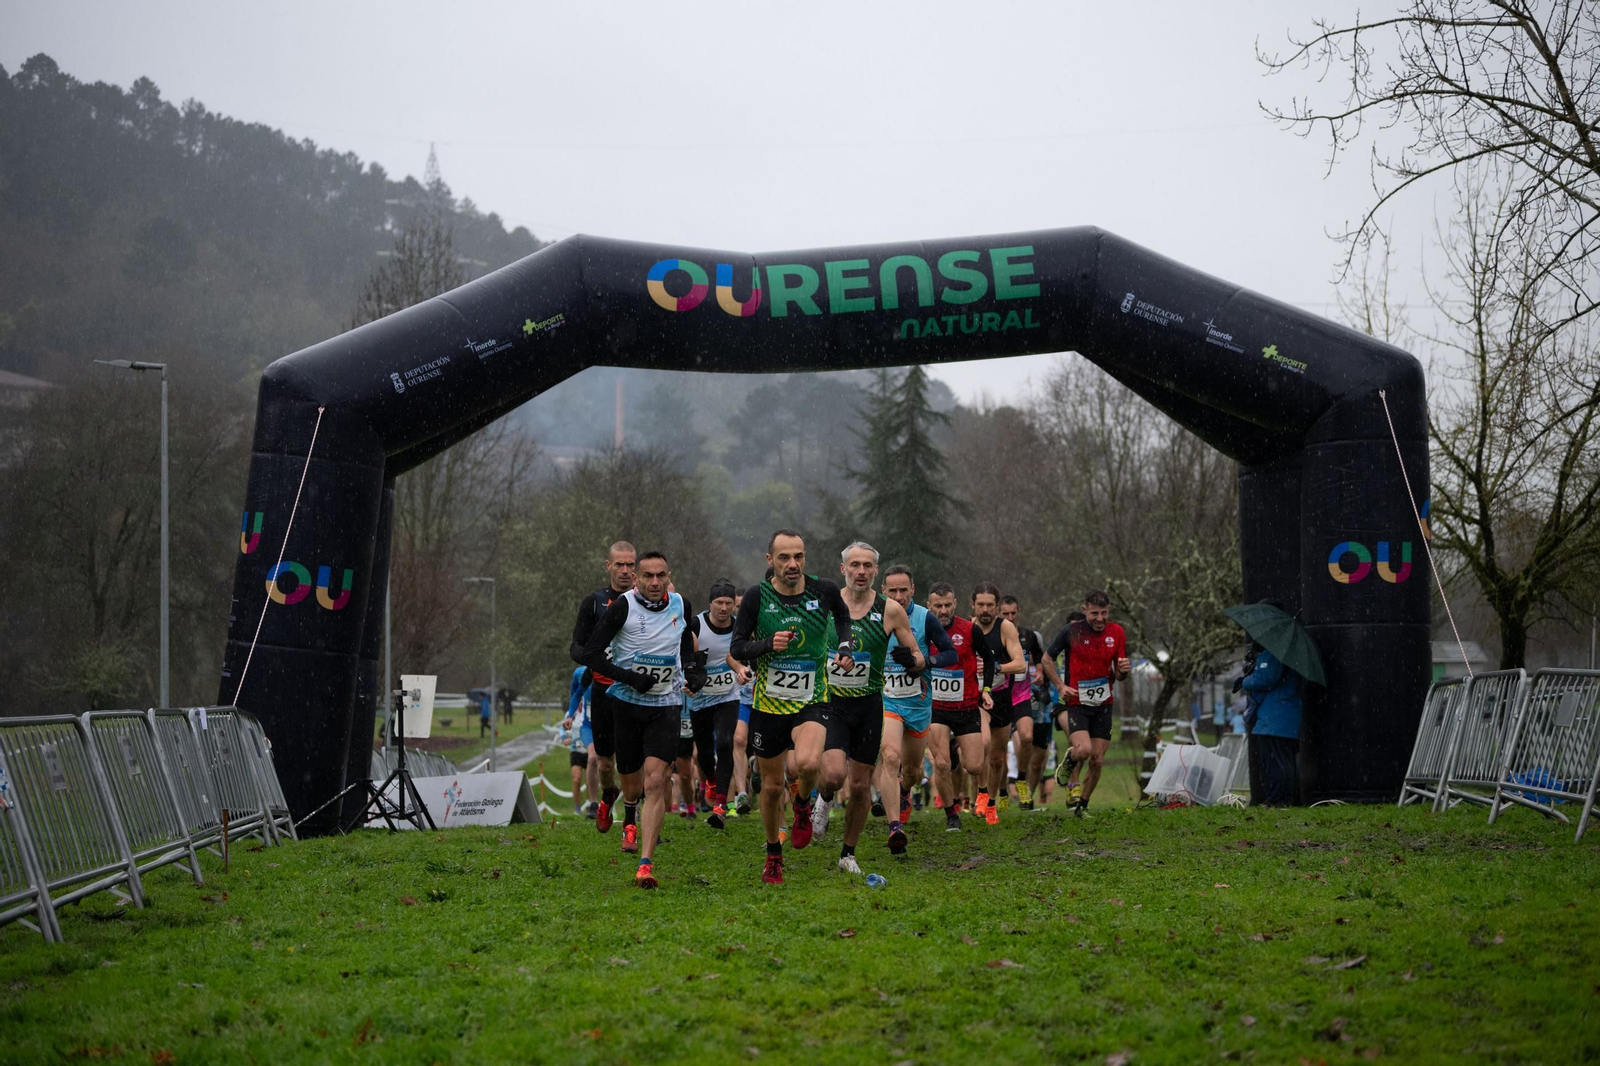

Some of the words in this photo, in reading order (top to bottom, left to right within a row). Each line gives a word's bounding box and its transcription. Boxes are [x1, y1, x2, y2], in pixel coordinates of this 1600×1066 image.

[647, 245, 1041, 318] OURENSE
[1133, 308, 1169, 327] OURENSE
[1136, 300, 1184, 324] DEPUTACIÓN
[534, 313, 565, 331] DEPORTE
[899, 308, 1041, 340] NATURAL
[1208, 328, 1233, 342] inorde
[474, 338, 497, 352] inorde
[403, 356, 451, 380] DEPUTACIÓN
[1272, 353, 1308, 371] DEPORTE
[407, 369, 443, 387] OURENSE
[1328, 541, 1412, 584] OU
[265, 560, 354, 611] OU
[781, 616, 803, 624] LUCUS
[850, 625, 863, 633] CUS
[705, 672, 734, 688] 248
[773, 670, 810, 689] 221
[888, 674, 914, 688] 110
[932, 678, 960, 692] 100
[1087, 687, 1105, 700] 99
[458, 808, 486, 816] Atletismo
[481, 798, 504, 808] Galega
